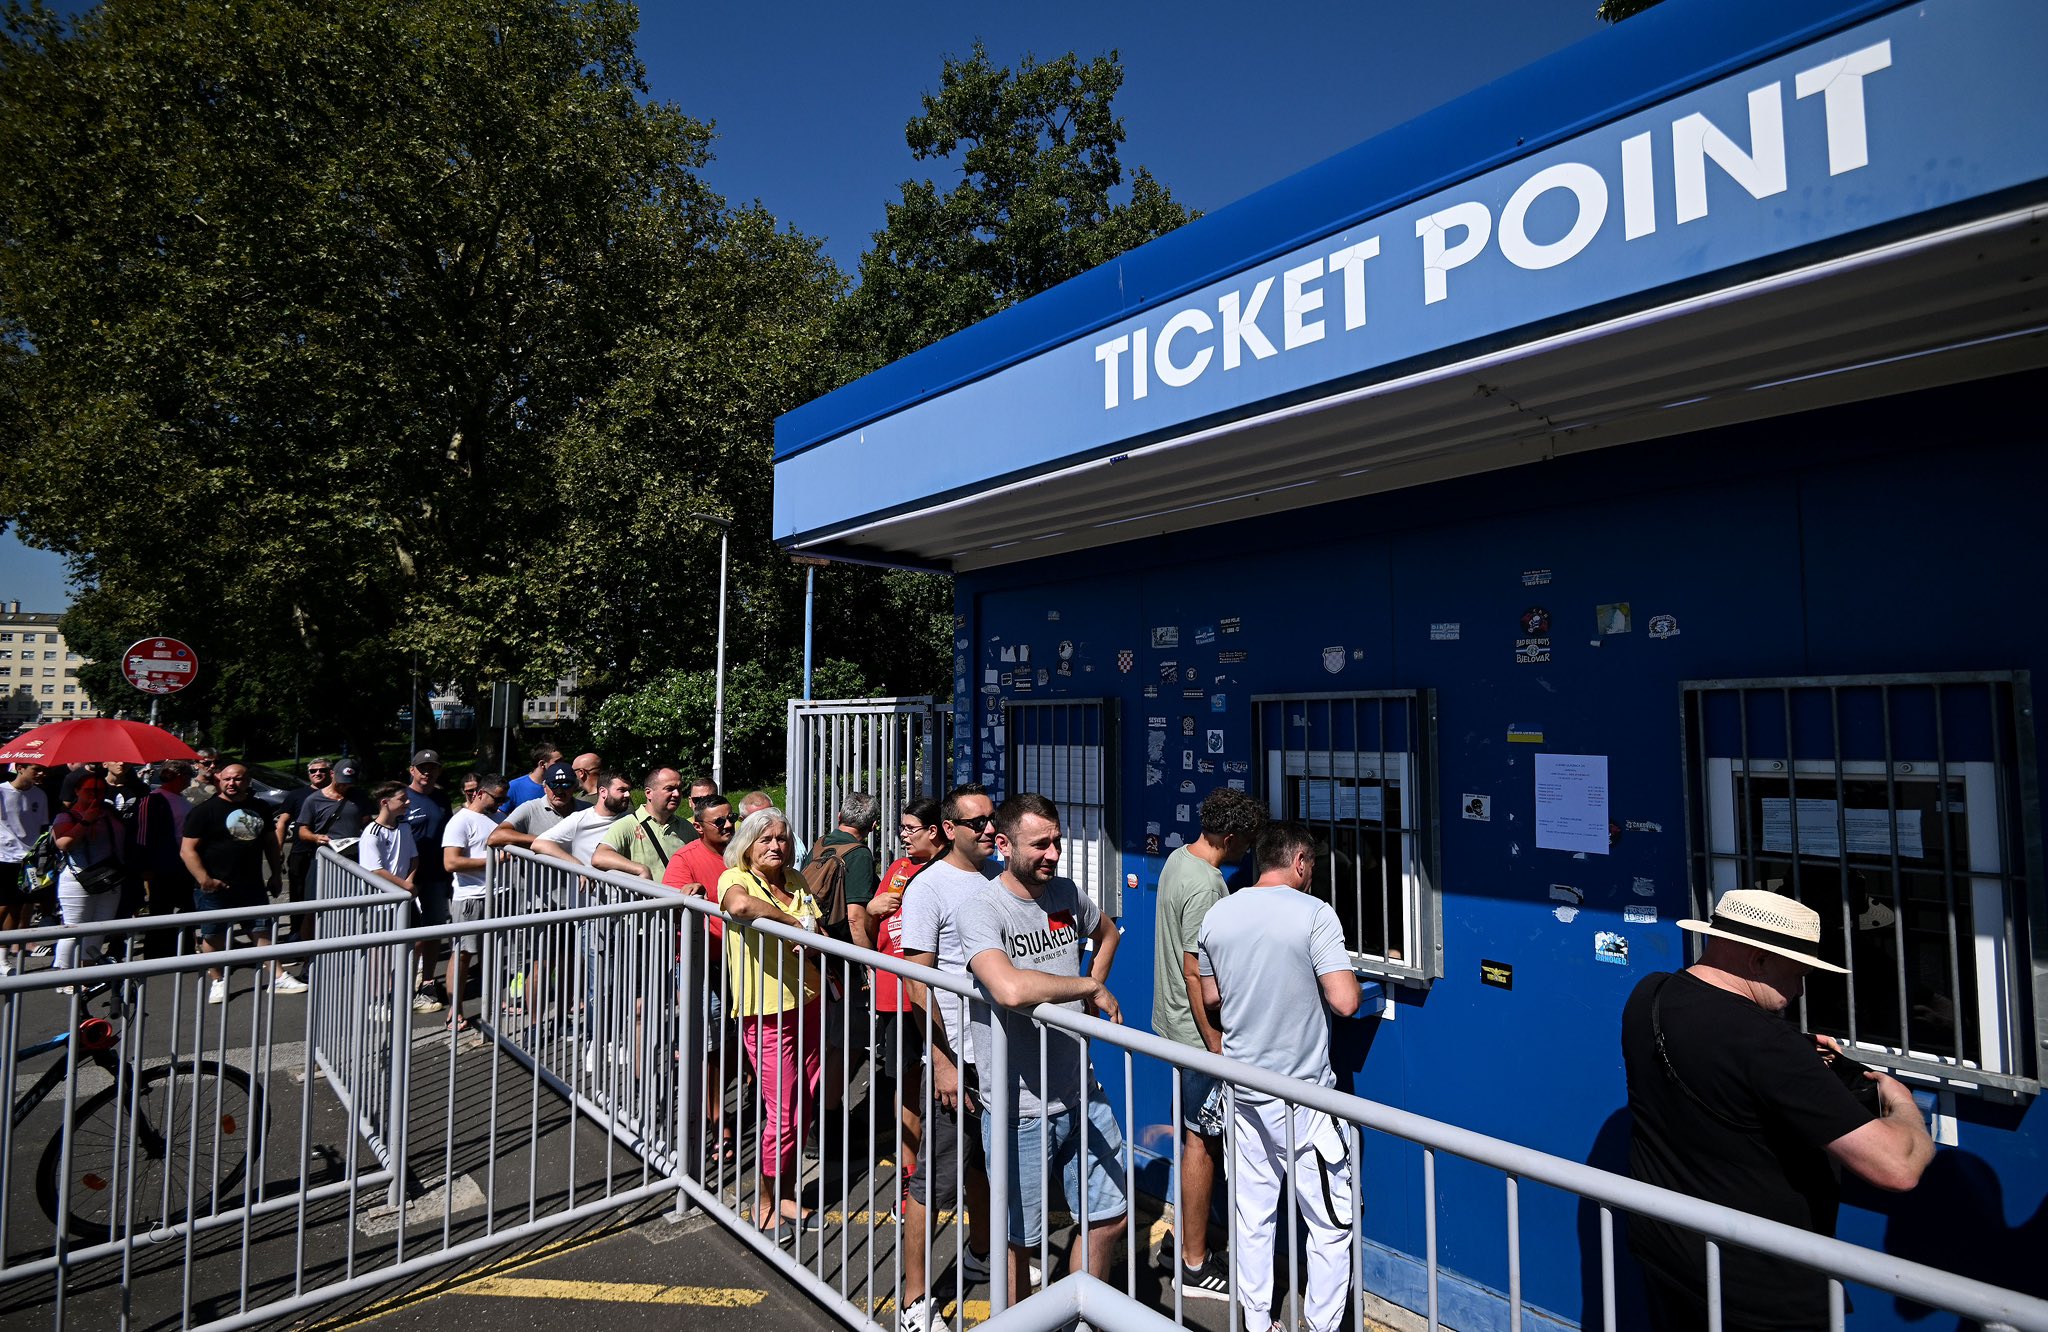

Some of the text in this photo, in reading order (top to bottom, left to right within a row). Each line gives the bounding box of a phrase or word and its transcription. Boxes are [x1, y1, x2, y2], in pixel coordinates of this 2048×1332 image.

[1095, 38, 1893, 410] TICKET POINT
[1516, 653, 1550, 663] BJELOVAR
[12, 751, 46, 759] Maurier
